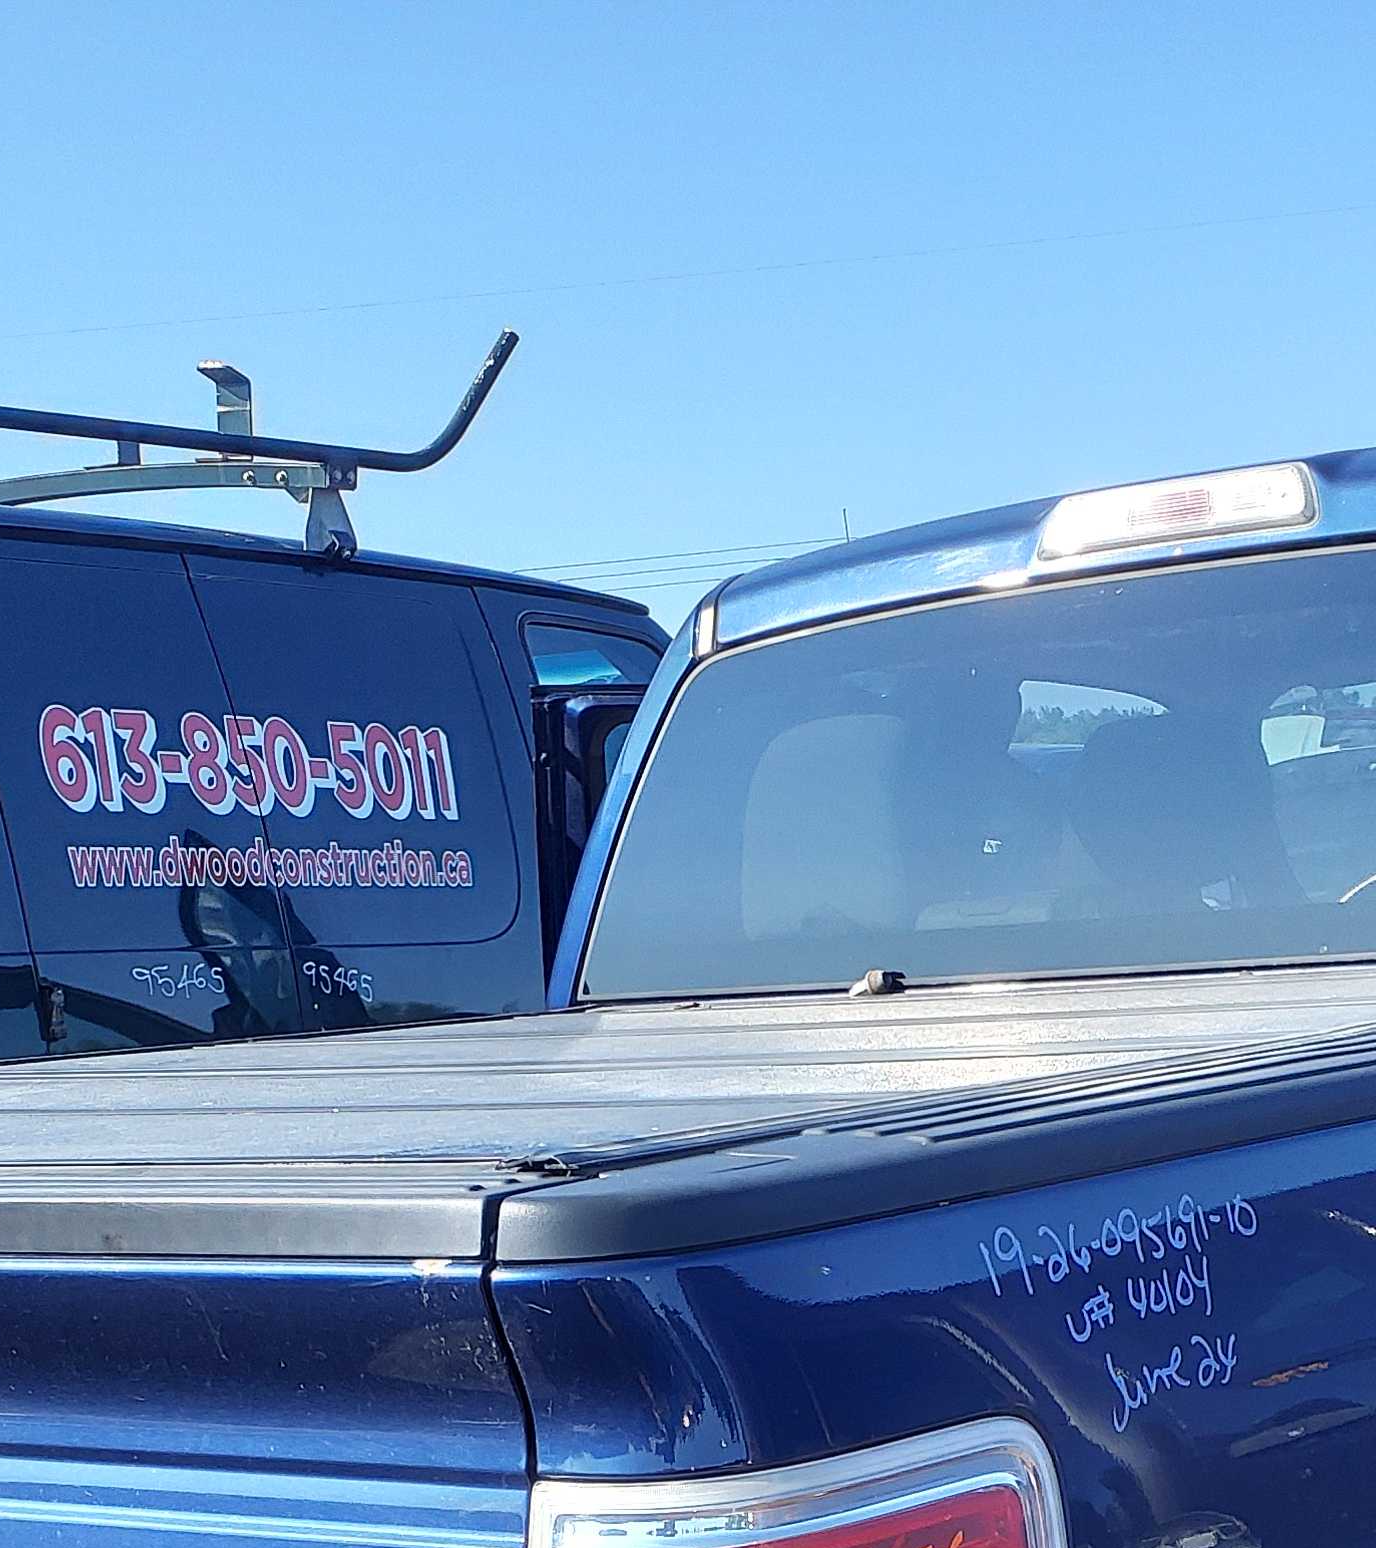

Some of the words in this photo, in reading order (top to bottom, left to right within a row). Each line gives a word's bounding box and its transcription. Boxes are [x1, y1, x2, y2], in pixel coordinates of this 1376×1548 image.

[39, 704, 459, 820] 613-850-5011
[68, 835, 472, 887] www.dwoodconstruction.ca
[132, 965, 225, 998] 95465
[302, 961, 373, 1002] 95465
[1105, 1346, 1191, 1432] June
